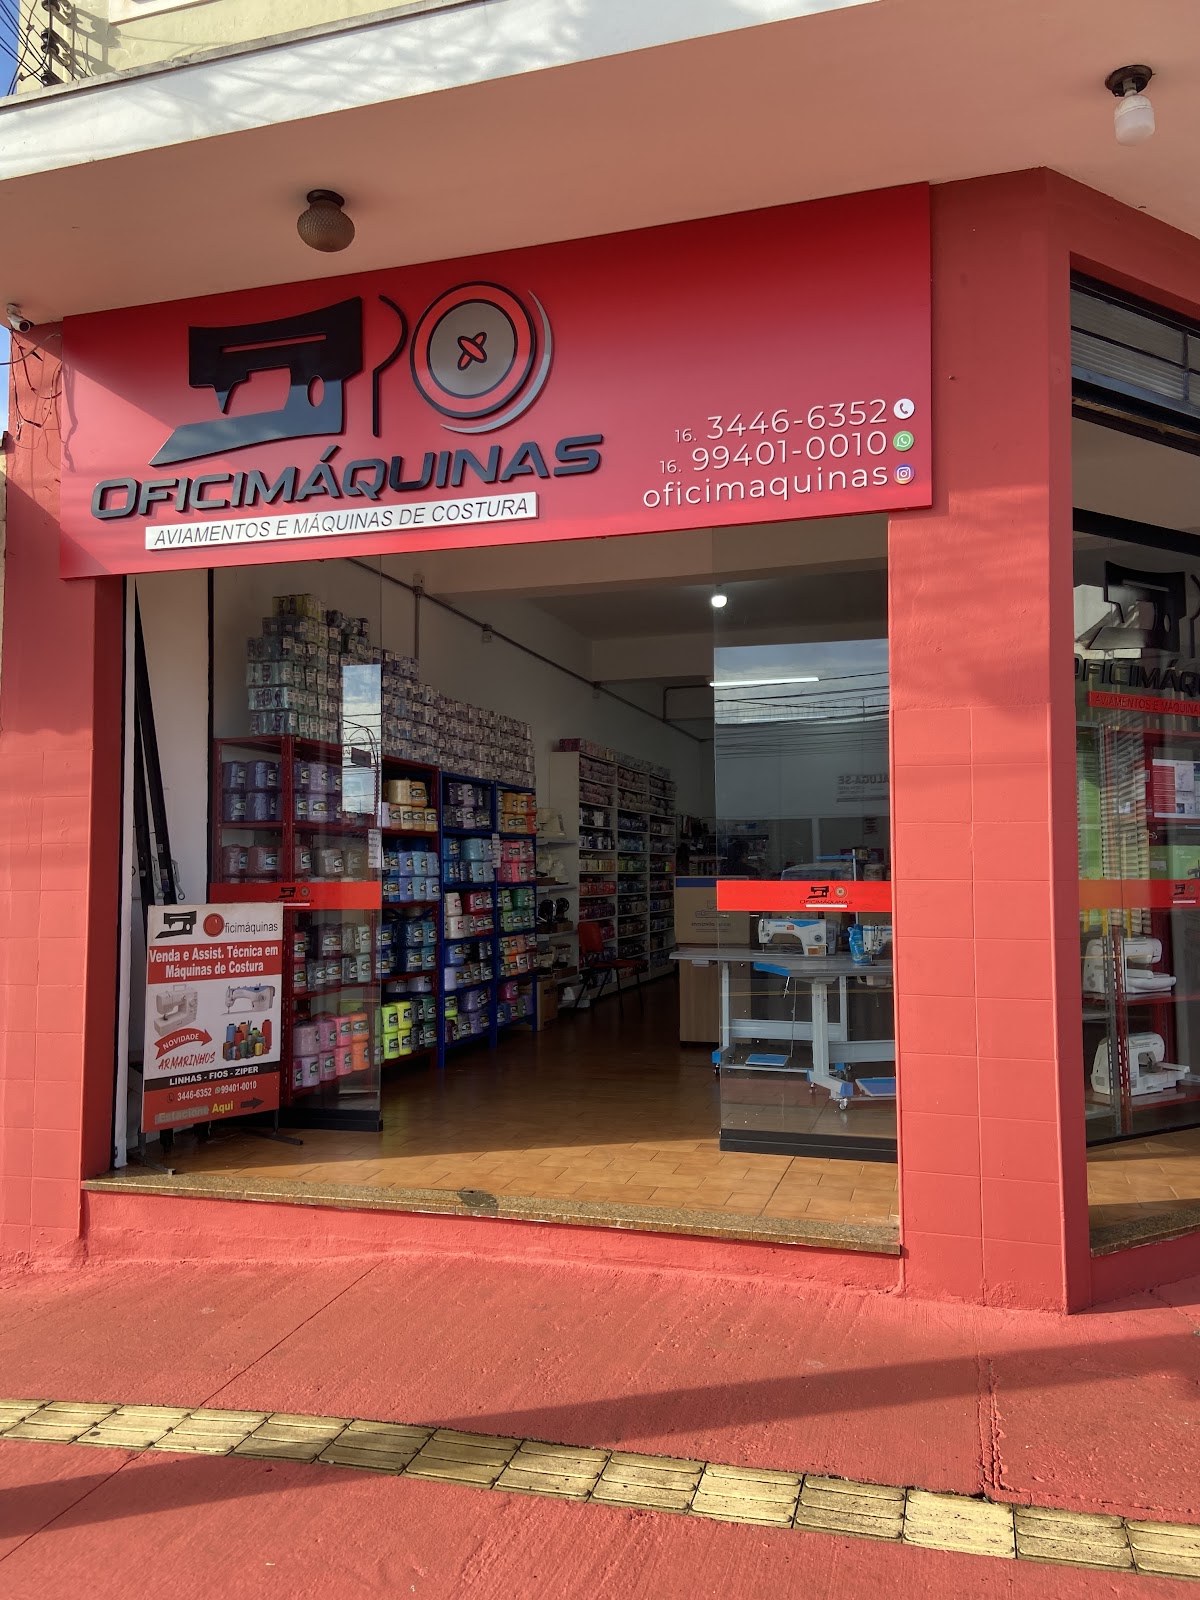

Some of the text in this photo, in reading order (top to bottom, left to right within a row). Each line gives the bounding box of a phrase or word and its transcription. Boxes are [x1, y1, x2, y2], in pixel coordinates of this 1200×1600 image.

[675, 399, 888, 443] 16. 3446-6352
[660, 430, 888, 474] 16. 99401-0010
[91, 434, 604, 519] OFICIMÁQUINAS
[643, 466, 888, 508] oficimaquinas
[154, 497, 529, 546] AVIAMENTOS E MÁQUINAS DE COSTURA
[1095, 694, 1151, 710] AVIAMENTOS
[1153, 702, 1159, 711] E
[149, 944, 279, 963] Venda e Assist. Técnica em
[165, 961, 264, 980] Máquinas de Costura
[162, 1032, 199, 1050] NOVIDADE
[158, 1051, 216, 1070] ARMARINHOS
[169, 1075, 202, 1086] LINHAS
[209, 1070, 229, 1080] FIOS
[234, 1066, 259, 1076] ZIPER
[177, 1080, 257, 1102] 3446-6352 99401-0010
[211, 1100, 234, 1114] Aqui
